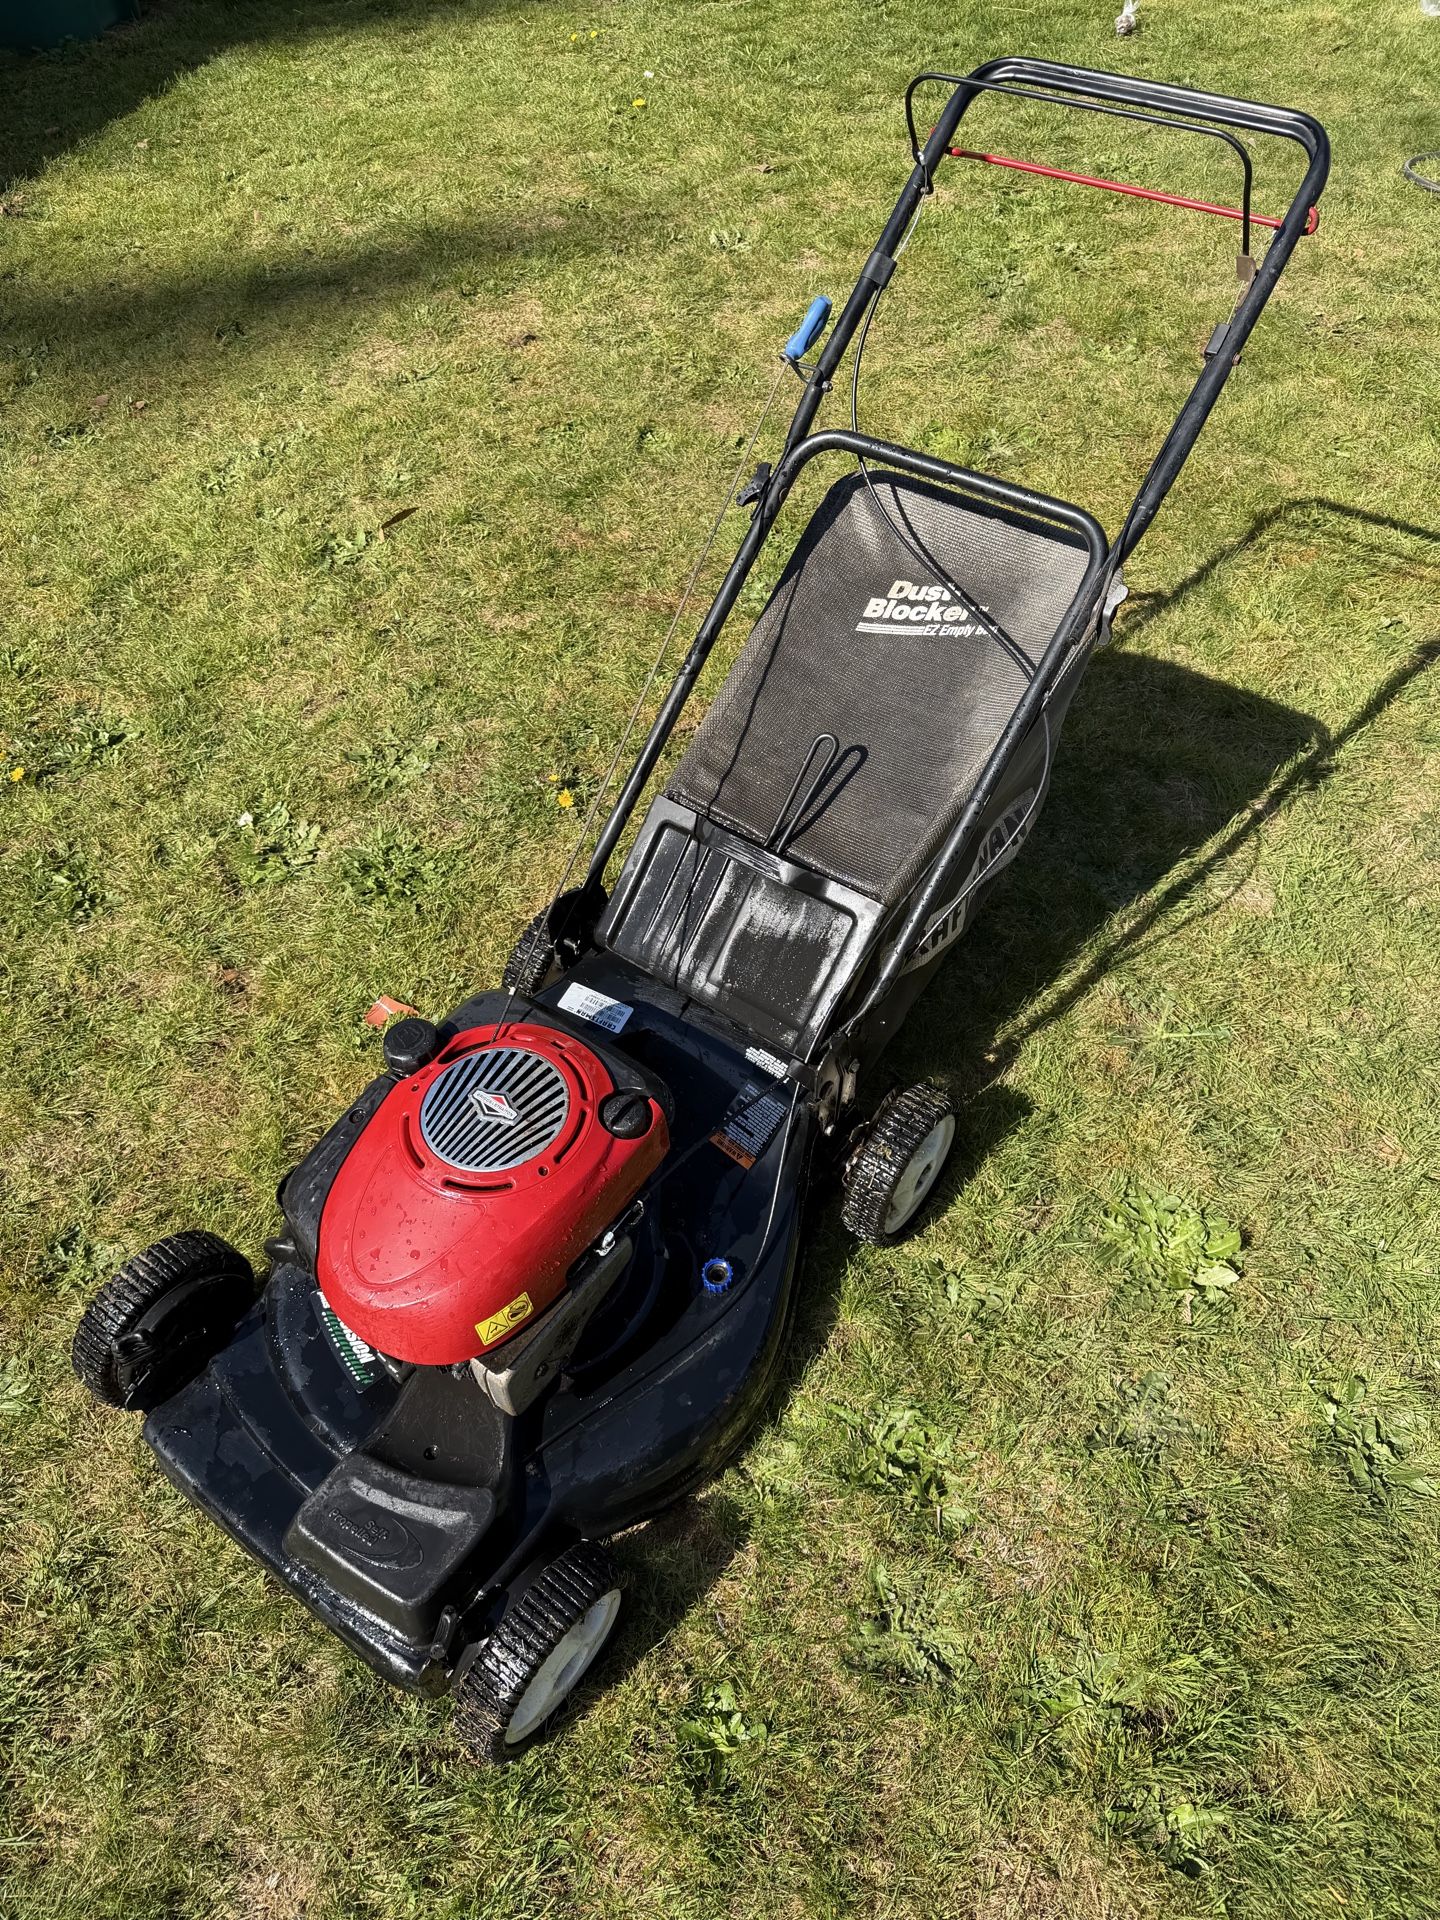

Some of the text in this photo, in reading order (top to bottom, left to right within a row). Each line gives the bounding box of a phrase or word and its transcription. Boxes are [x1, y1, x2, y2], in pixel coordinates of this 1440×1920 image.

[923, 624, 940, 636] EZ
[939, 624, 976, 638] Empty
[576, 1008, 617, 1031] CRAFTSMAN
[328, 1508, 377, 1547] Propelled
